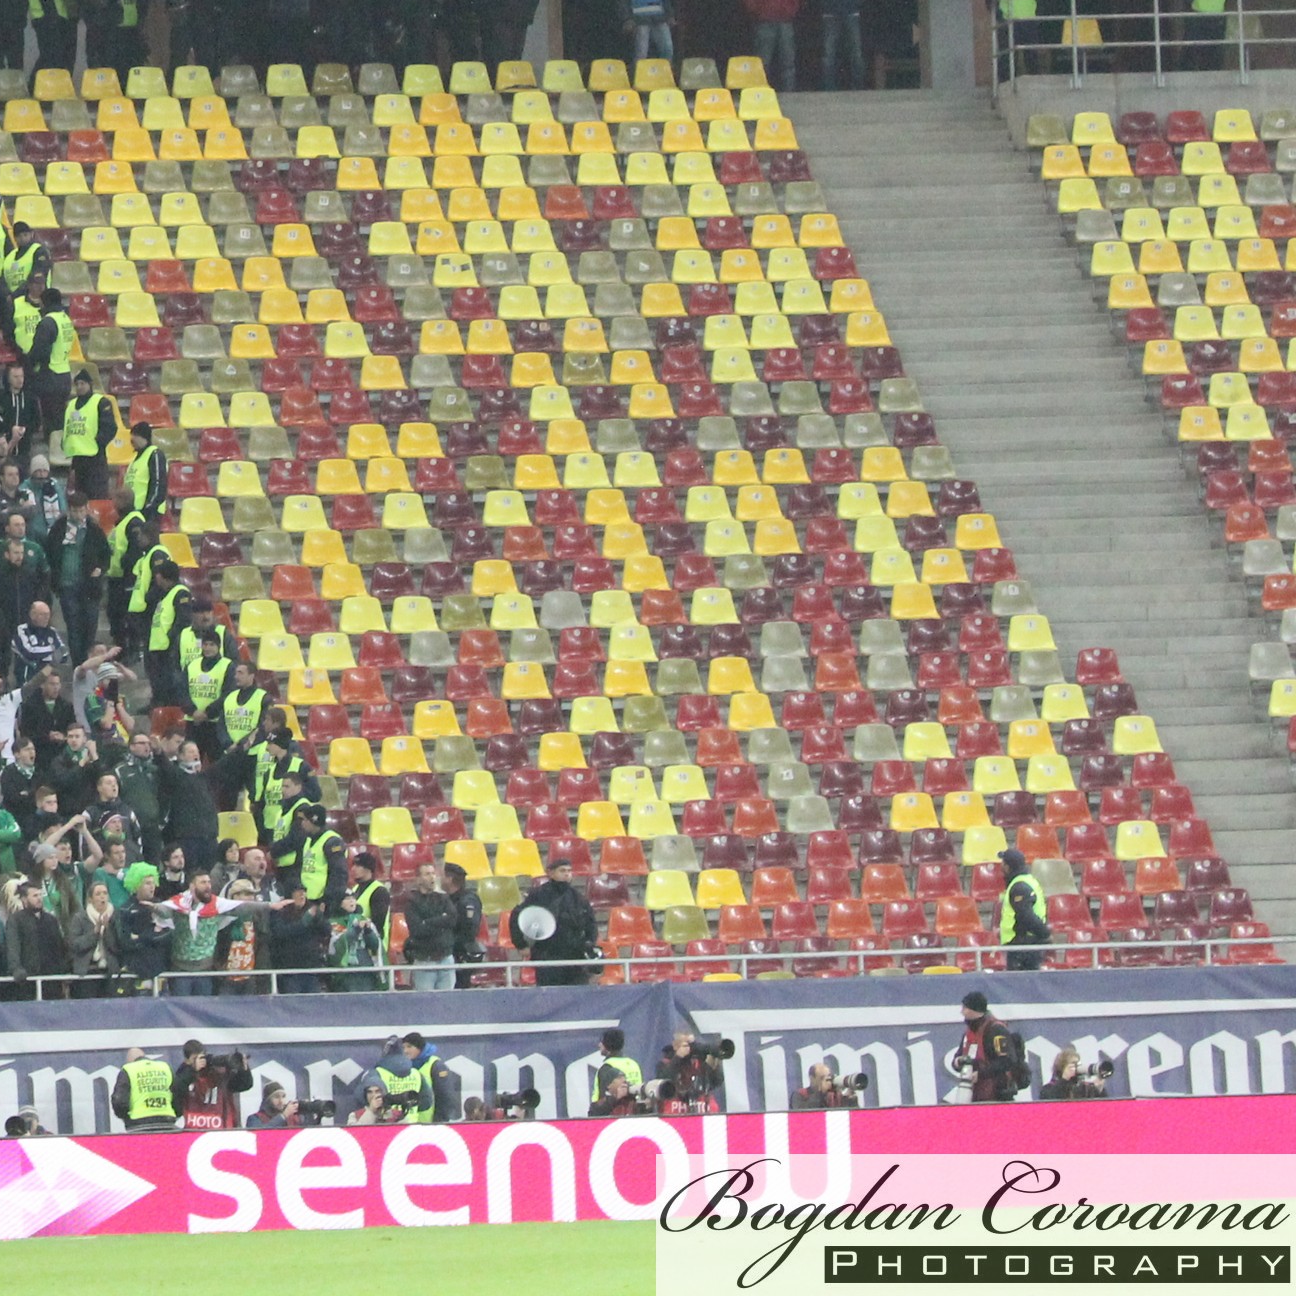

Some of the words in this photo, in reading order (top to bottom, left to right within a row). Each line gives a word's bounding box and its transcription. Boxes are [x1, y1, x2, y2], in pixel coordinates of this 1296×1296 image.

[136, 1072, 168, 1081] ALISTAR
[137, 1079, 168, 1087] SECURITY
[145, 1107, 167, 1118] 1234
[187, 1111, 852, 1234] seenow
